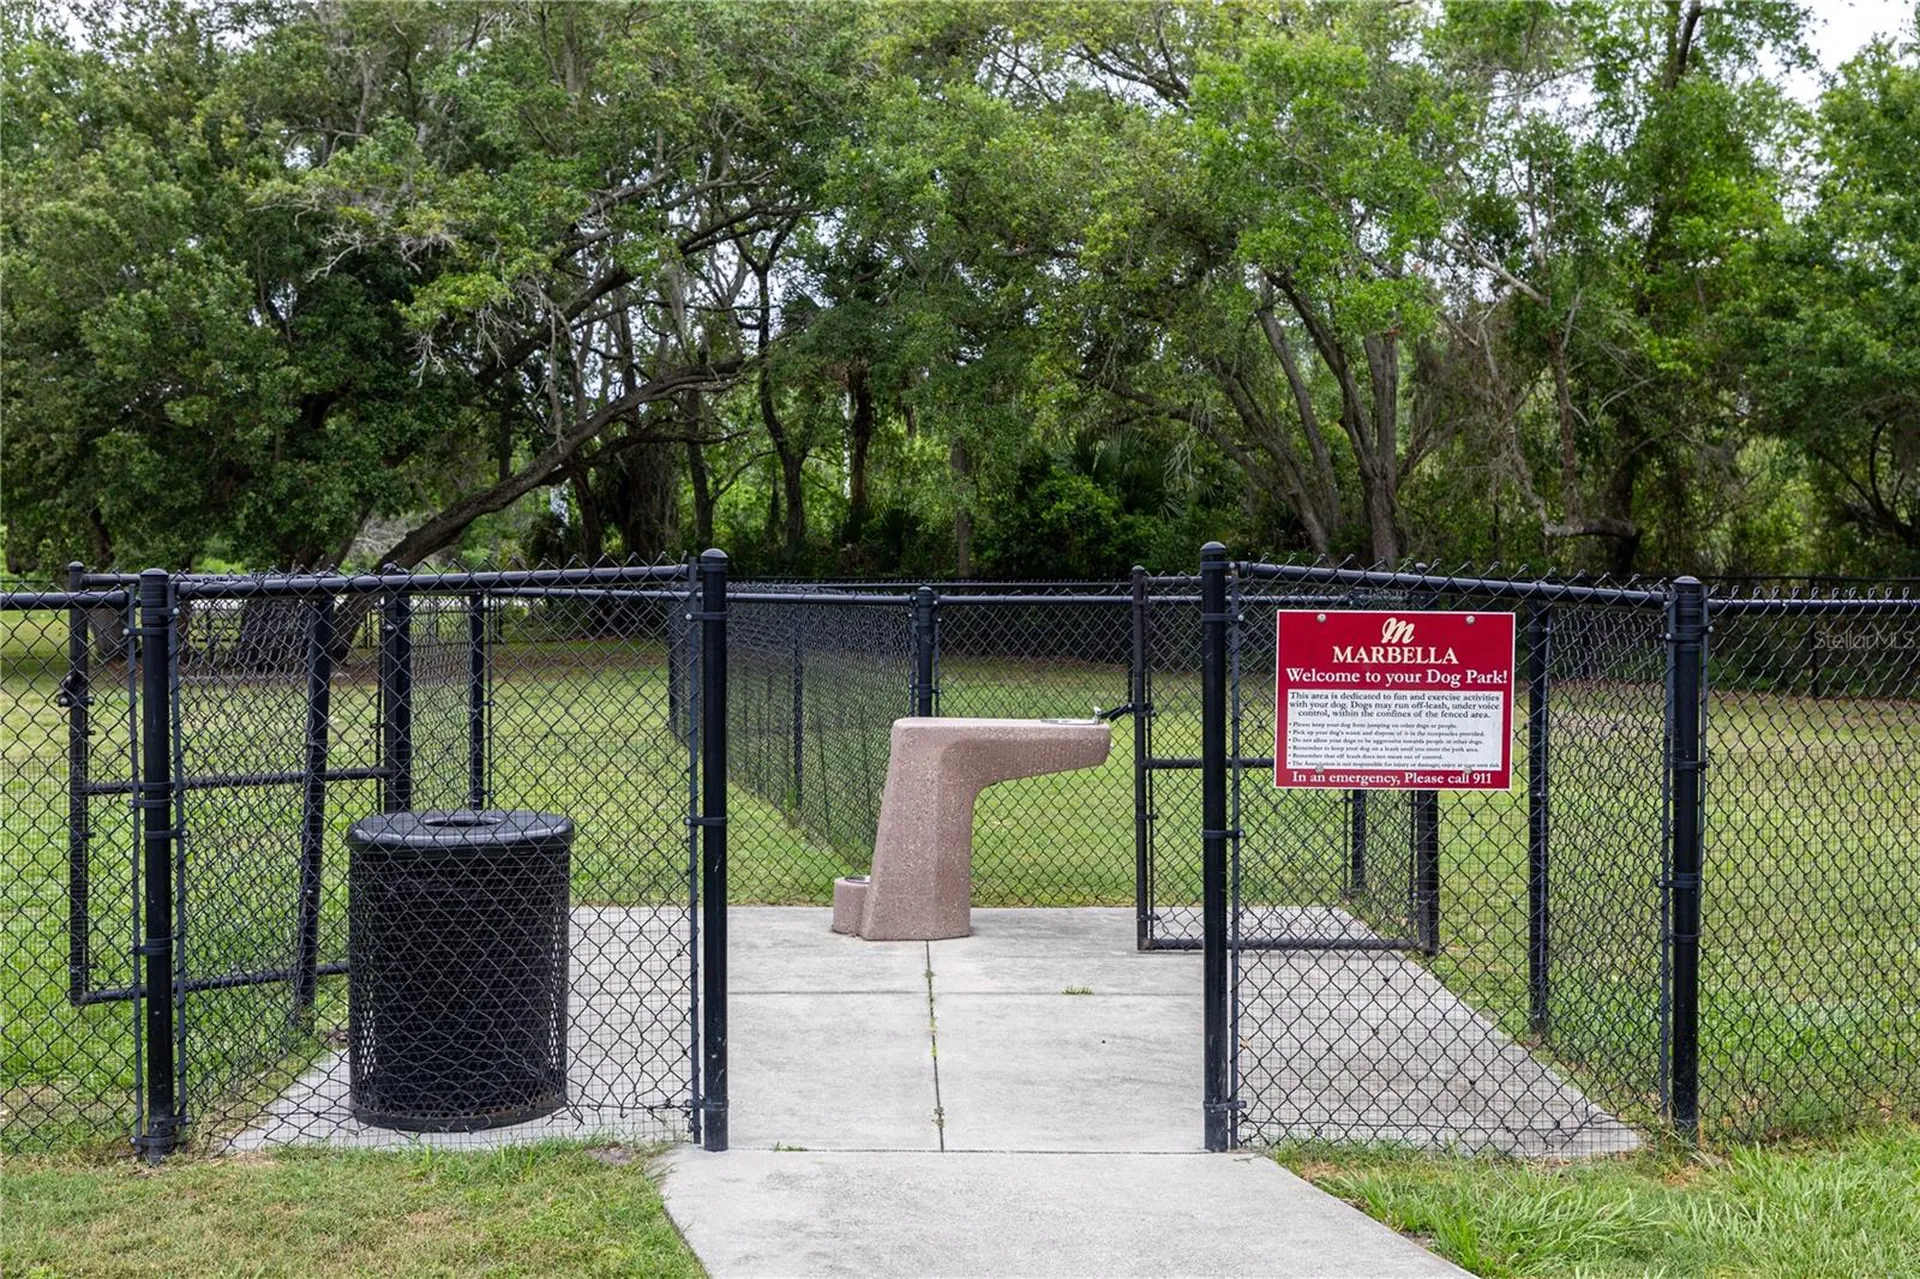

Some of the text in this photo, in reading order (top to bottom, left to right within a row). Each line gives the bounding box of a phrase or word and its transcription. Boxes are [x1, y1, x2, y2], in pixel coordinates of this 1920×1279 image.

[1332, 646, 1459, 665] MARBELLA
[1286, 668, 1507, 687] Welcome to your Dog Park!
[1291, 692, 1309, 700] This
[1331, 692, 1338, 700] is
[1340, 692, 1381, 701] dedicated
[1383, 693, 1392, 701] to
[1394, 692, 1407, 701] fun
[1409, 693, 1425, 701] and
[1427, 693, 1461, 701] exercise
[1463, 693, 1500, 701] activities
[1310, 702, 1329, 711] your
[1330, 701, 1348, 710] dog.
[1350, 701, 1373, 710] Dogs
[1375, 703, 1392, 711] may
[1411, 702, 1449, 711] off-leash,
[1451, 702, 1477, 710] under
[1298, 710, 1330, 718] control,
[1376, 710, 1411, 718] confines
[1413, 710, 1423, 718] of
[1292, 771, 1492, 786] In an emergency, Please call 911
